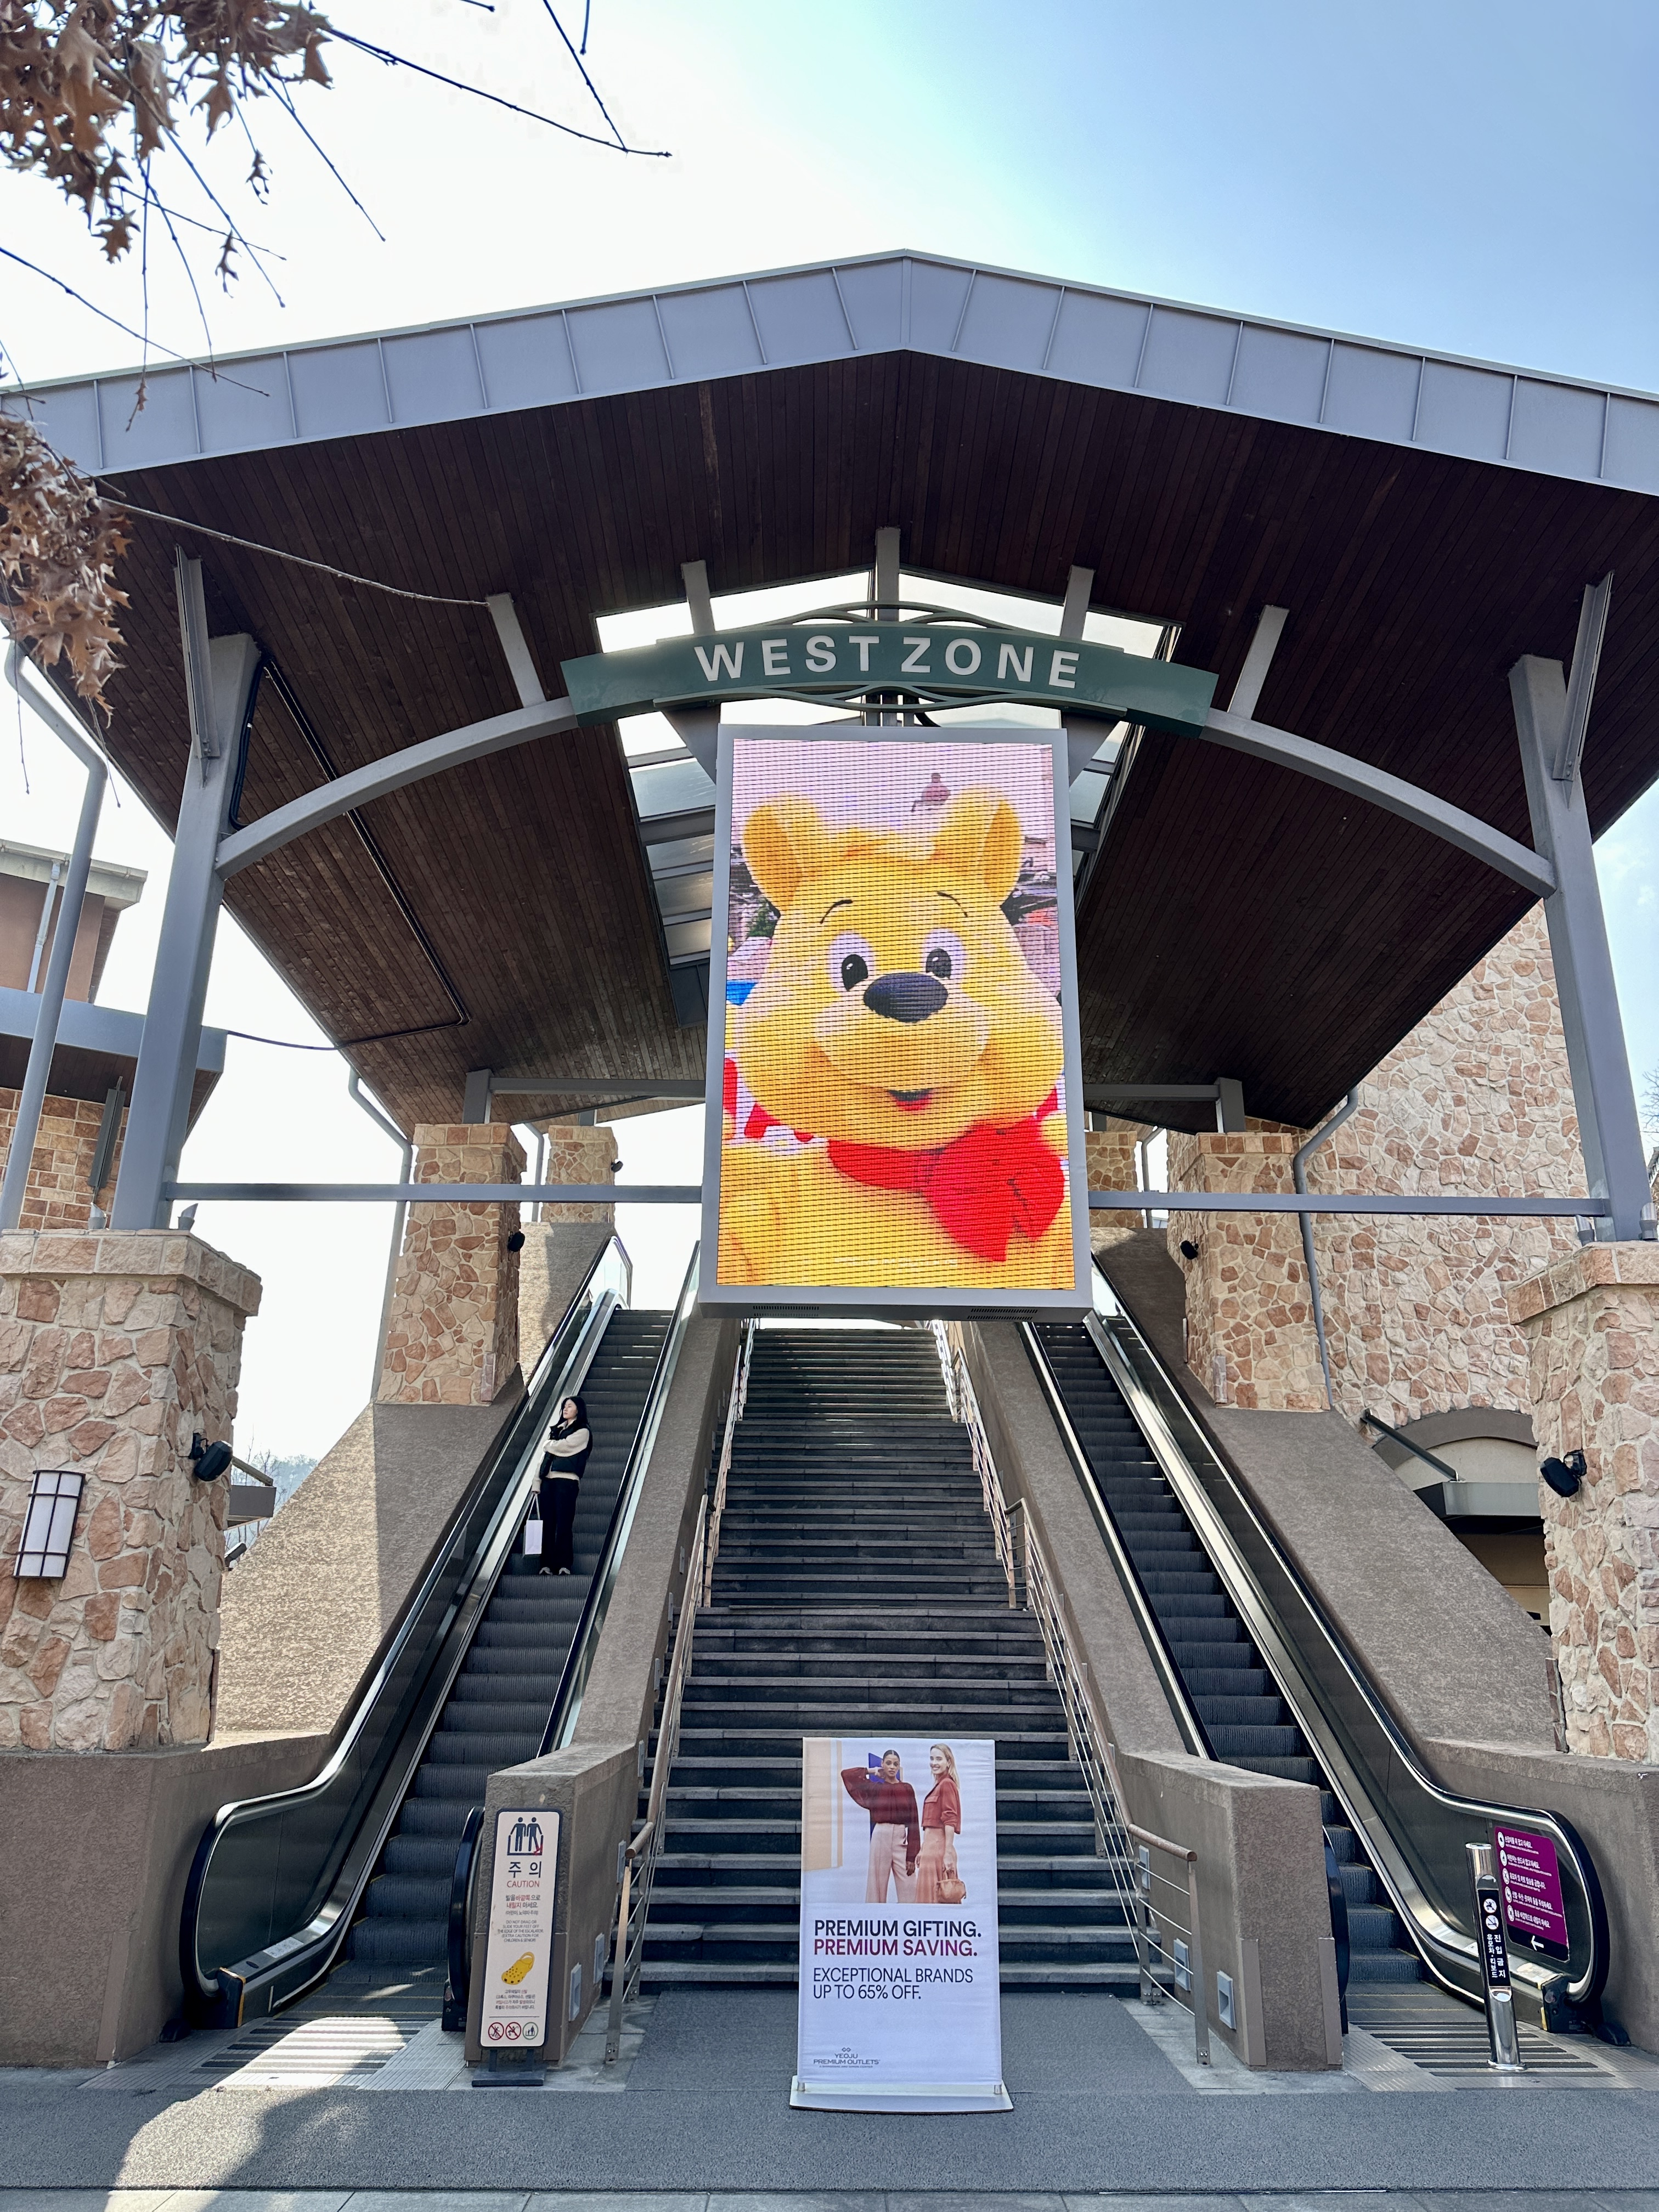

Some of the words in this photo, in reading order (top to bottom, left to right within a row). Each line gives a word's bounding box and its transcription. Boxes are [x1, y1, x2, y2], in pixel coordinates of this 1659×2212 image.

[694, 635, 879, 682] WEST
[901, 636, 1080, 690] ZONE
[814, 1920, 898, 1937] PREMIUM
[903, 1920, 981, 1937] GIFTING.
[814, 1939, 898, 1956] PREMIUM
[903, 1939, 978, 1956] SAVING.
[813, 1967, 912, 1982] EXCEPTIONAL
[916, 1968, 973, 1983] BRANDS
[813, 1985, 832, 1999] UP
[834, 1985, 855, 1999] TO
[858, 1984, 888, 1999] 65%
[892, 1985, 922, 2000] OFF.
